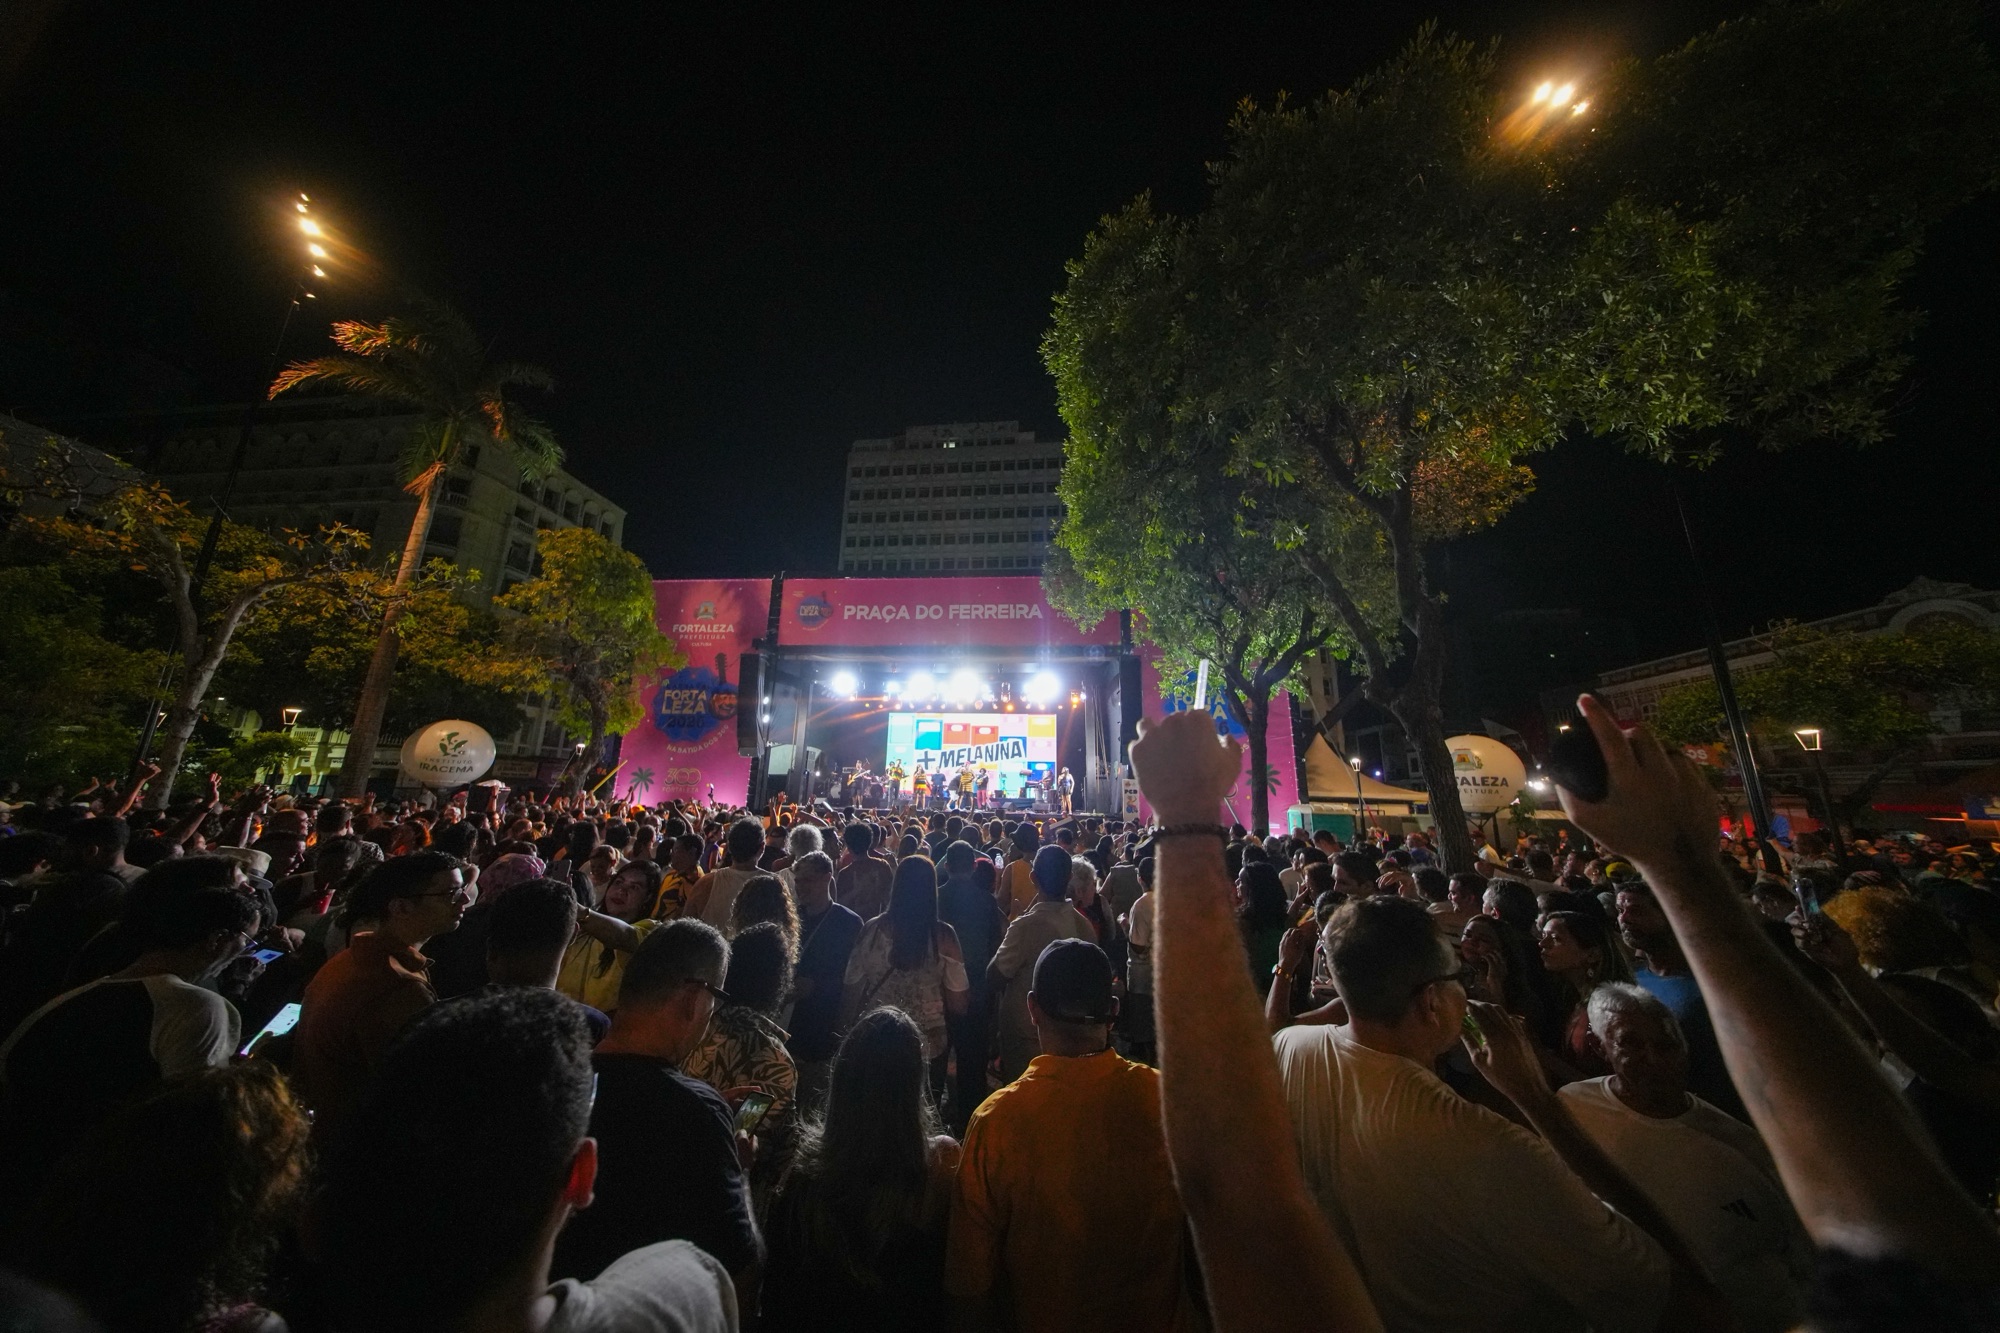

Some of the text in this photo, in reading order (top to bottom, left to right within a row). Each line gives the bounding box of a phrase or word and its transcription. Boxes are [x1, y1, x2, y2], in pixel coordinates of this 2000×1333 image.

[843, 605, 911, 623] PRAÇA
[915, 605, 944, 620] DO
[949, 604, 1043, 619] FERREIRA
[672, 624, 735, 633] FORTALEZA
[663, 690, 707, 700] FORTA
[661, 700, 706, 715] LEZA
[666, 744, 676, 752] NA
[677, 744, 704, 754] BATIDA
[939, 740, 1022, 769] MELANINA
[420, 762, 474, 773] IRACEMA
[665, 767, 702, 786] 300
